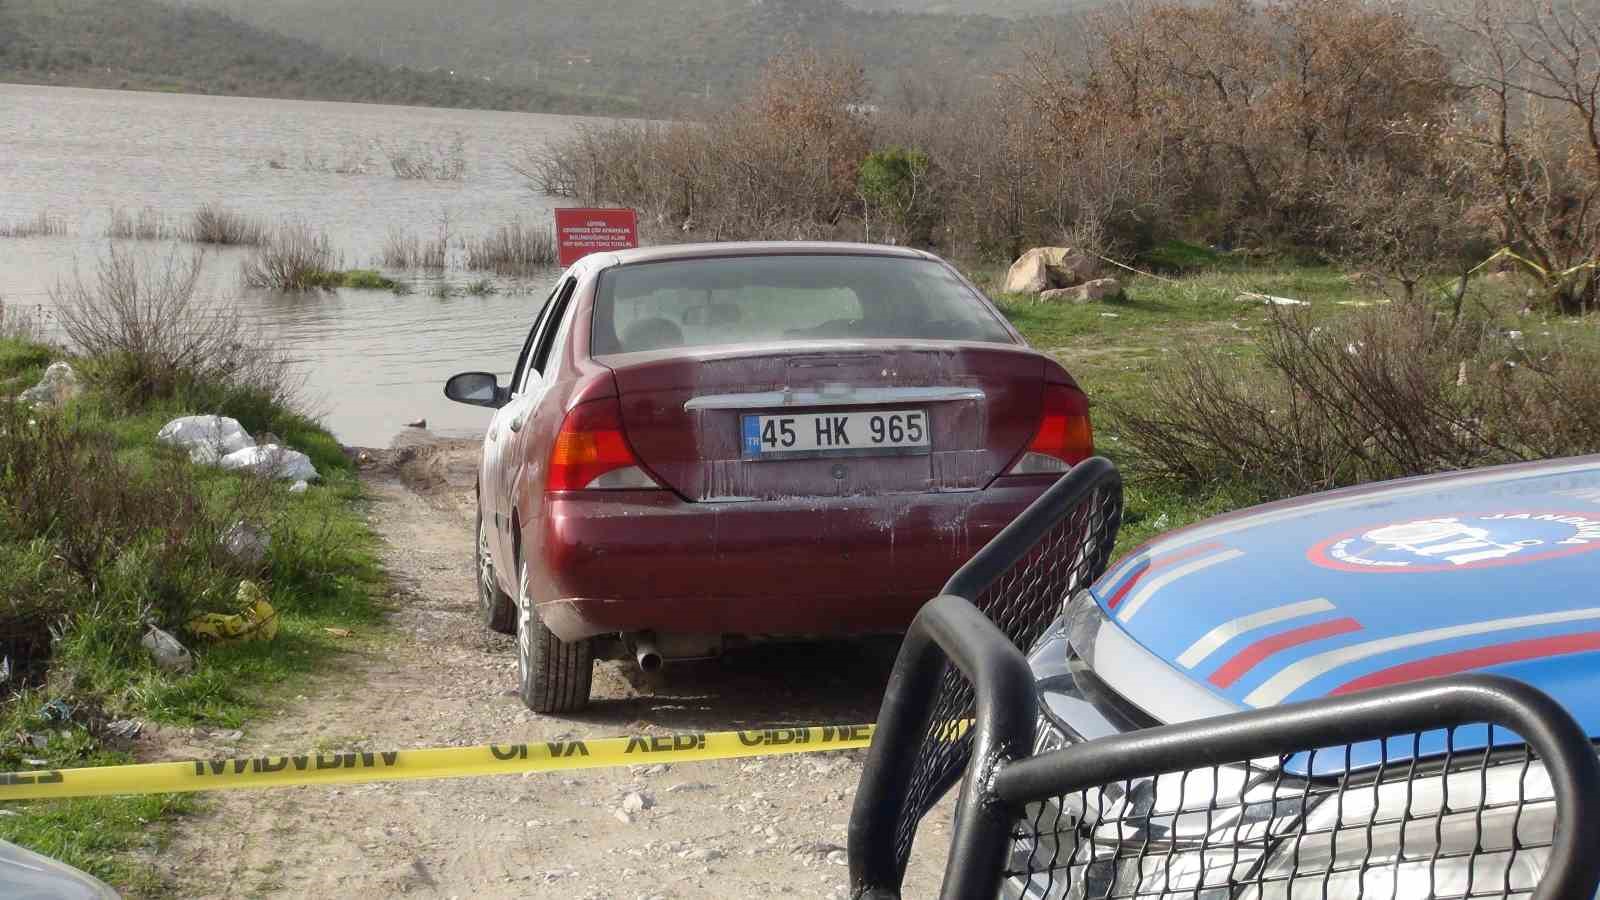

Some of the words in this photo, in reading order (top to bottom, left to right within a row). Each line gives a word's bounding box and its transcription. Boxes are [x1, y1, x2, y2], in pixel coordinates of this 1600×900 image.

[762, 418, 796, 448] 45
[815, 416, 850, 446] HK
[870, 413, 923, 443] 965
